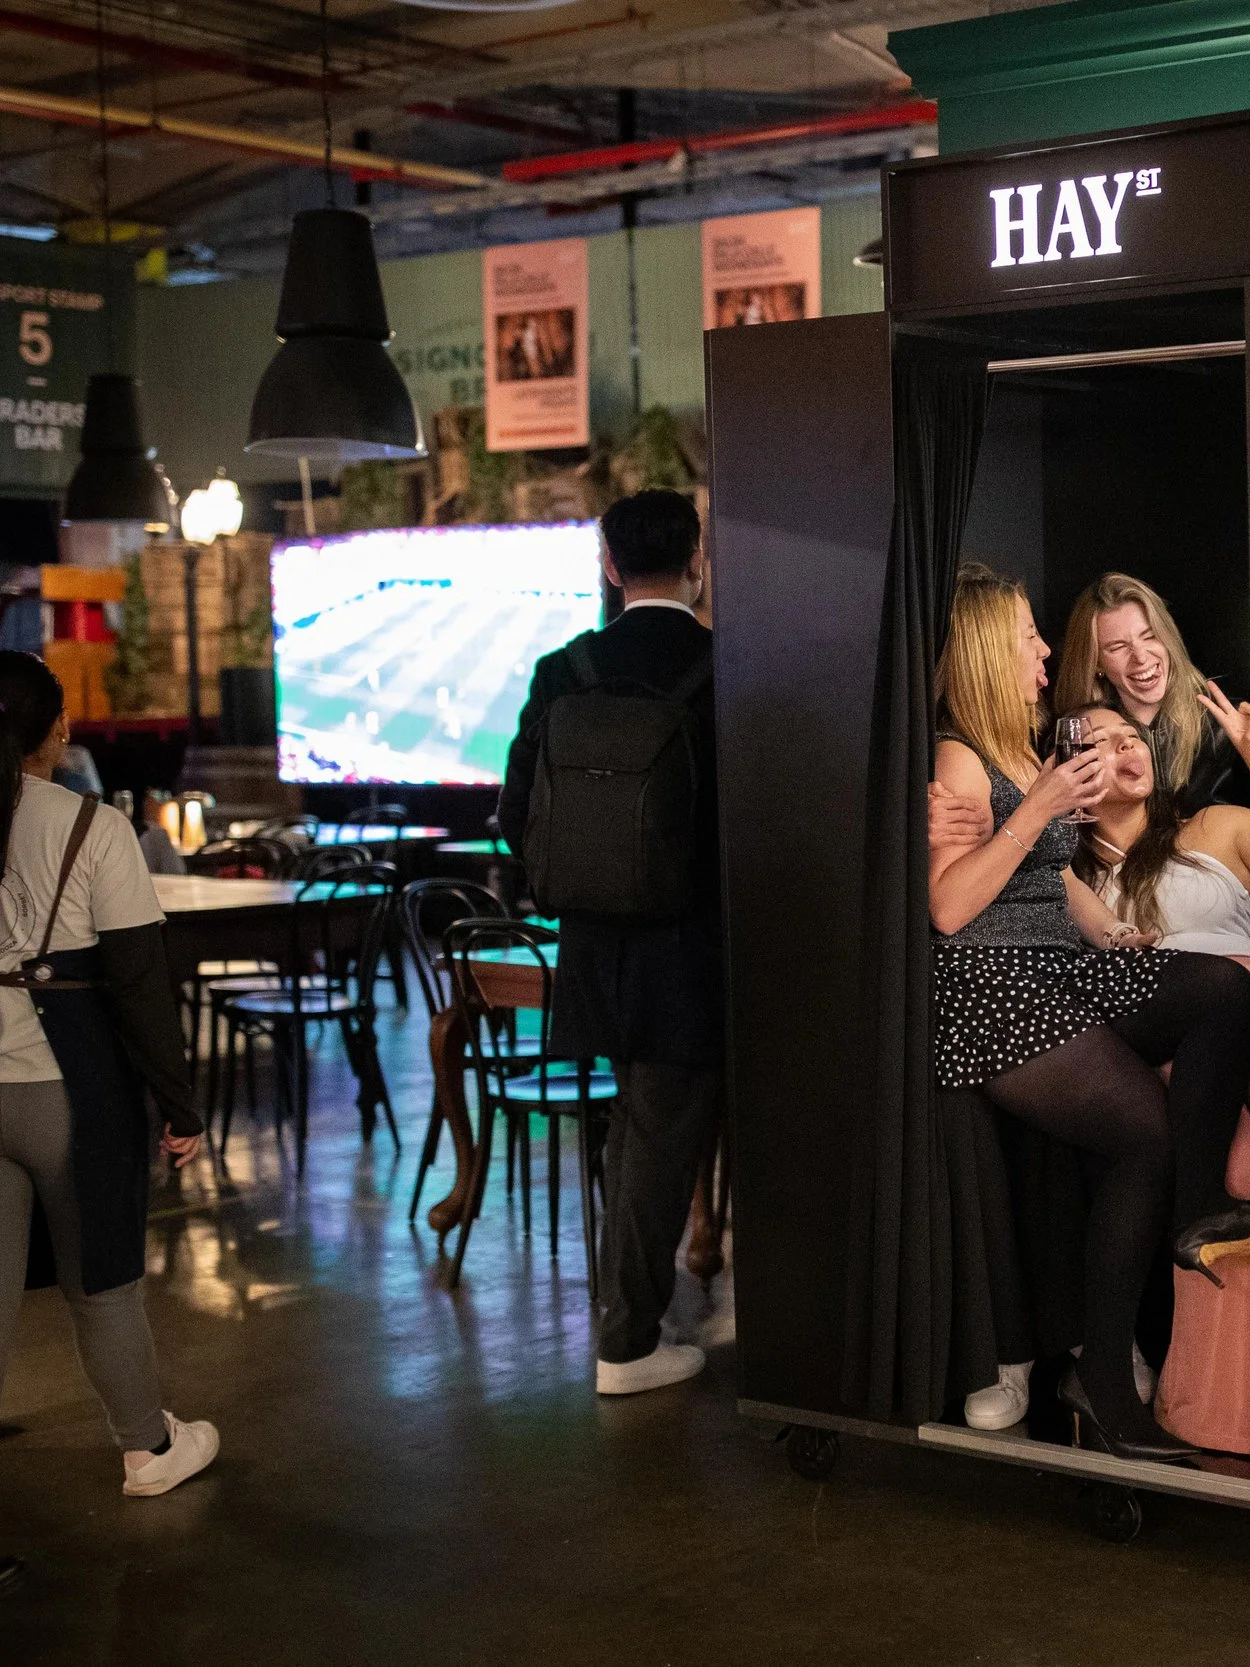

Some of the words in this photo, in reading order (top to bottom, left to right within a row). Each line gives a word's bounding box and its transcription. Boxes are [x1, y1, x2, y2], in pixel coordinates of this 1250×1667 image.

[989, 171, 1134, 268] HAY
[1135, 167, 1162, 192] ST
[19, 310, 53, 366] 5
[15, 424, 63, 450] BAR
